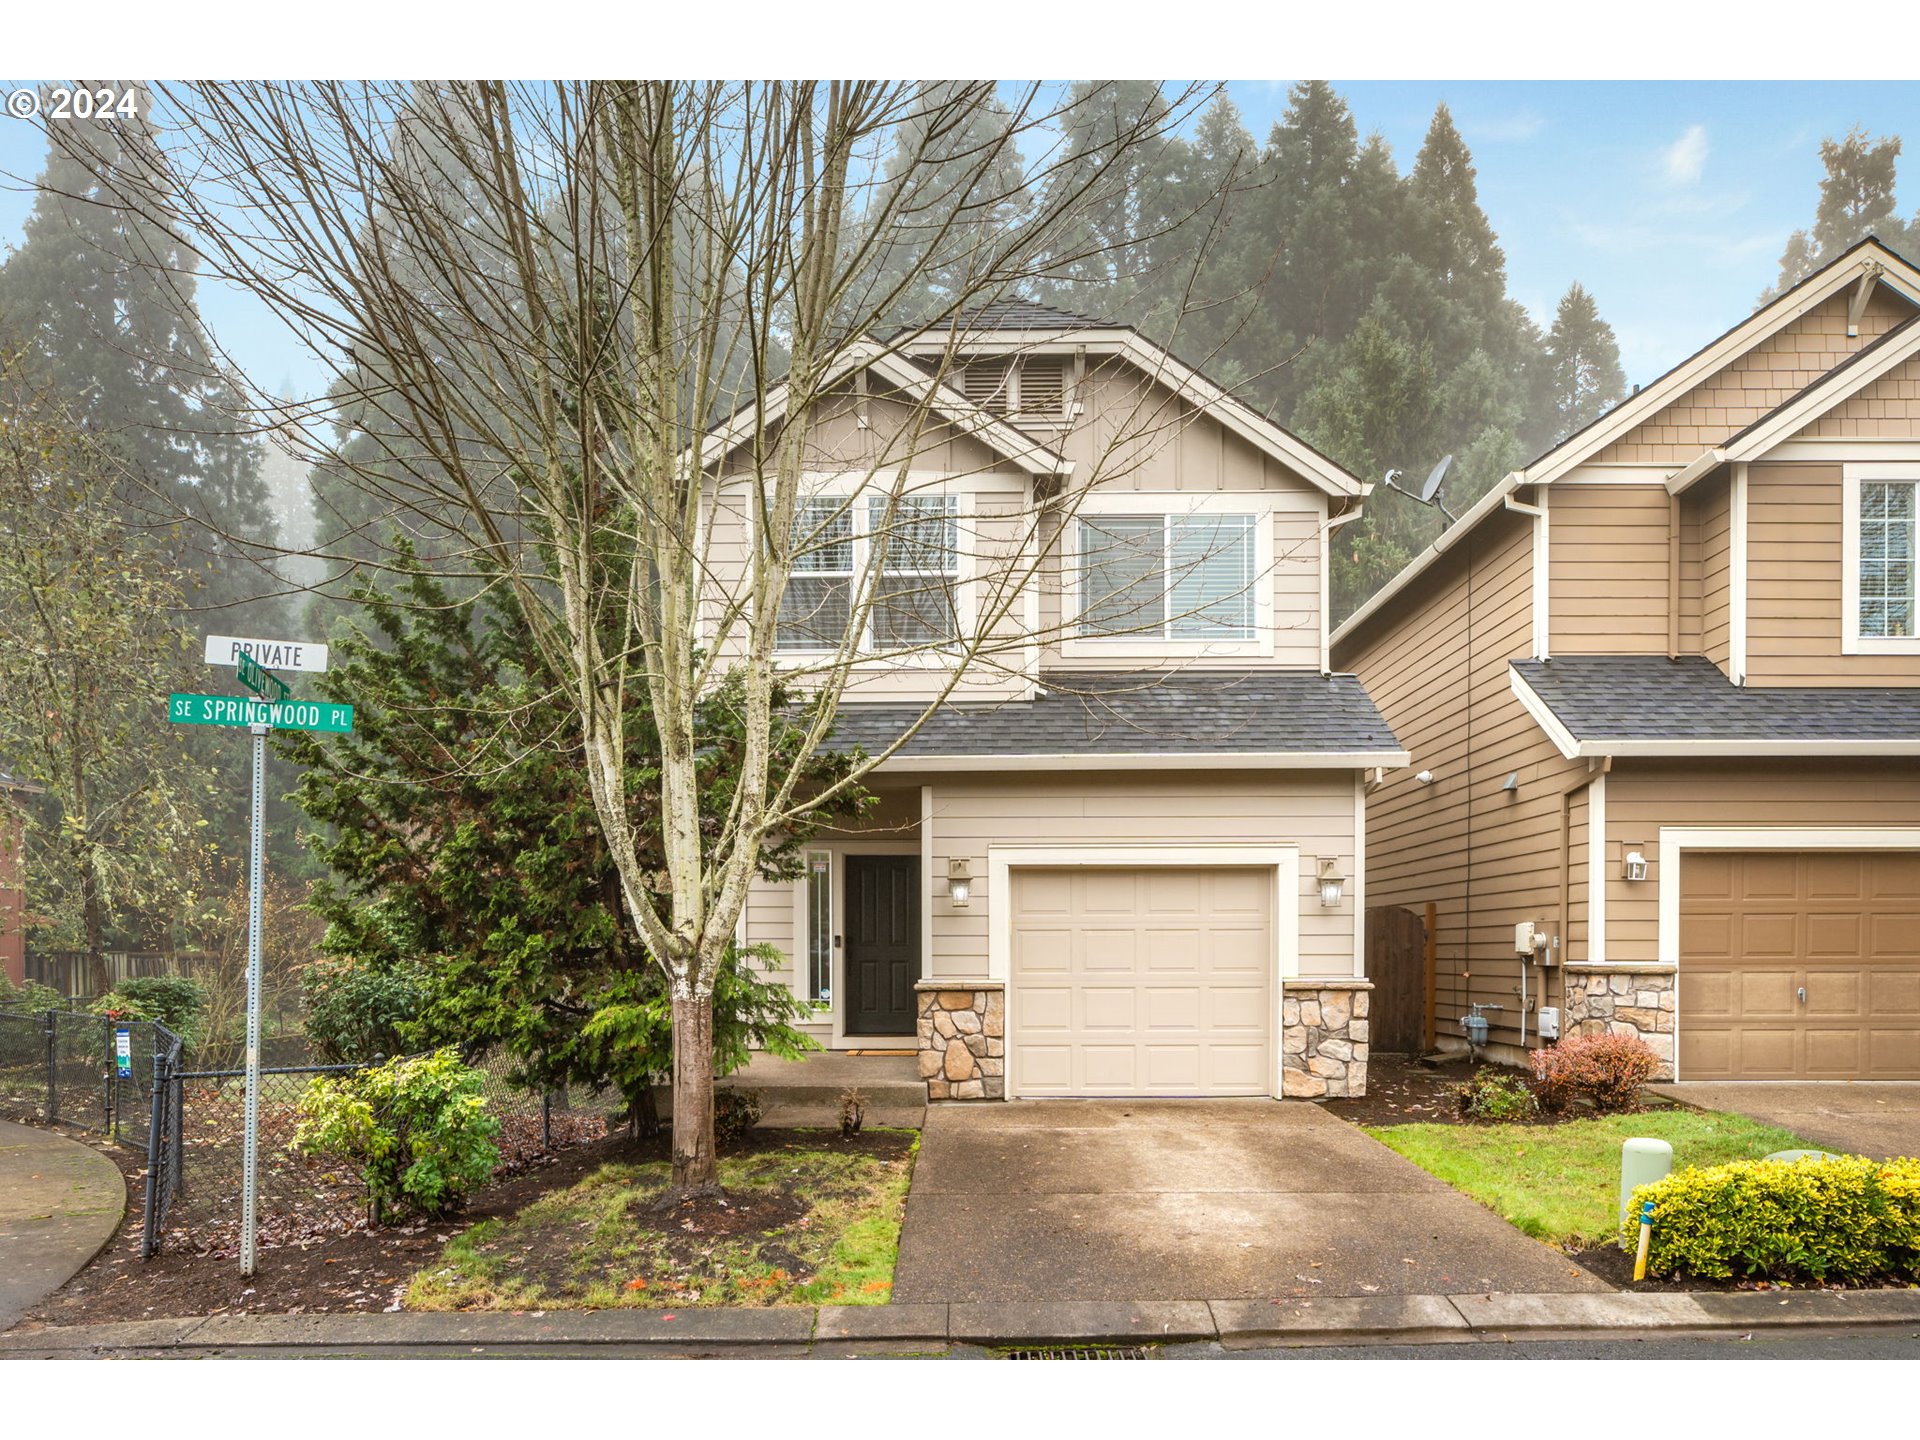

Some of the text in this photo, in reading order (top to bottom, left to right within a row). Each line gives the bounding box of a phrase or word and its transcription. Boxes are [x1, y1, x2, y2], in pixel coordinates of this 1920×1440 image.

[230, 641, 303, 667] PRIVATE
[175, 699, 348, 727] SE SPRINGWOOD PL
